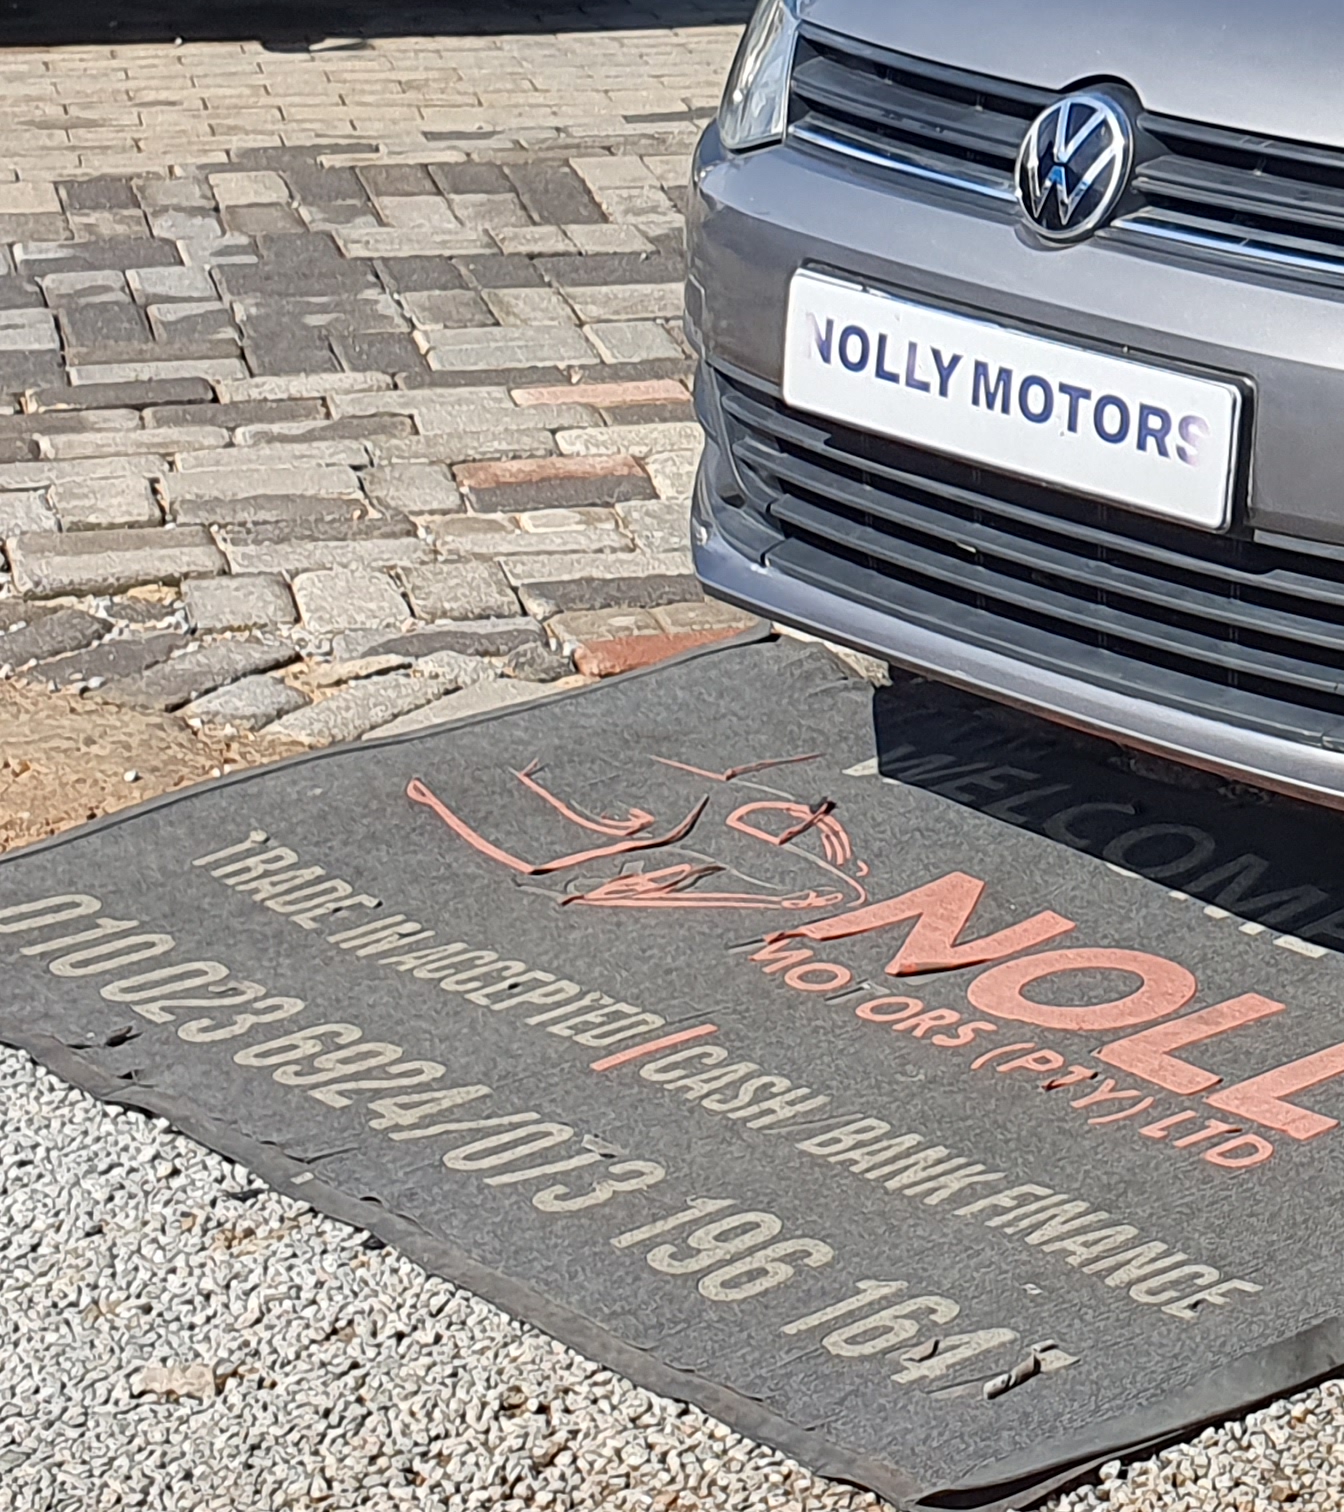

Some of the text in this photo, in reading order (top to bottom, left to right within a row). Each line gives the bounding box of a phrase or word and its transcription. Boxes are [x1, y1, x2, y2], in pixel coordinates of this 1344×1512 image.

[806, 312, 1212, 467] NOLLY MOTORS
[191, 829, 383, 930] TRADE
[326, 913, 437, 958] IN
[377, 941, 667, 1048] ACCEPTED
[747, 938, 999, 1048] MOTORS
[1139, 1109, 1275, 1168] LTD
[610, 1196, 836, 1302] 196
[952, 1183, 1265, 1319] FINANCE
